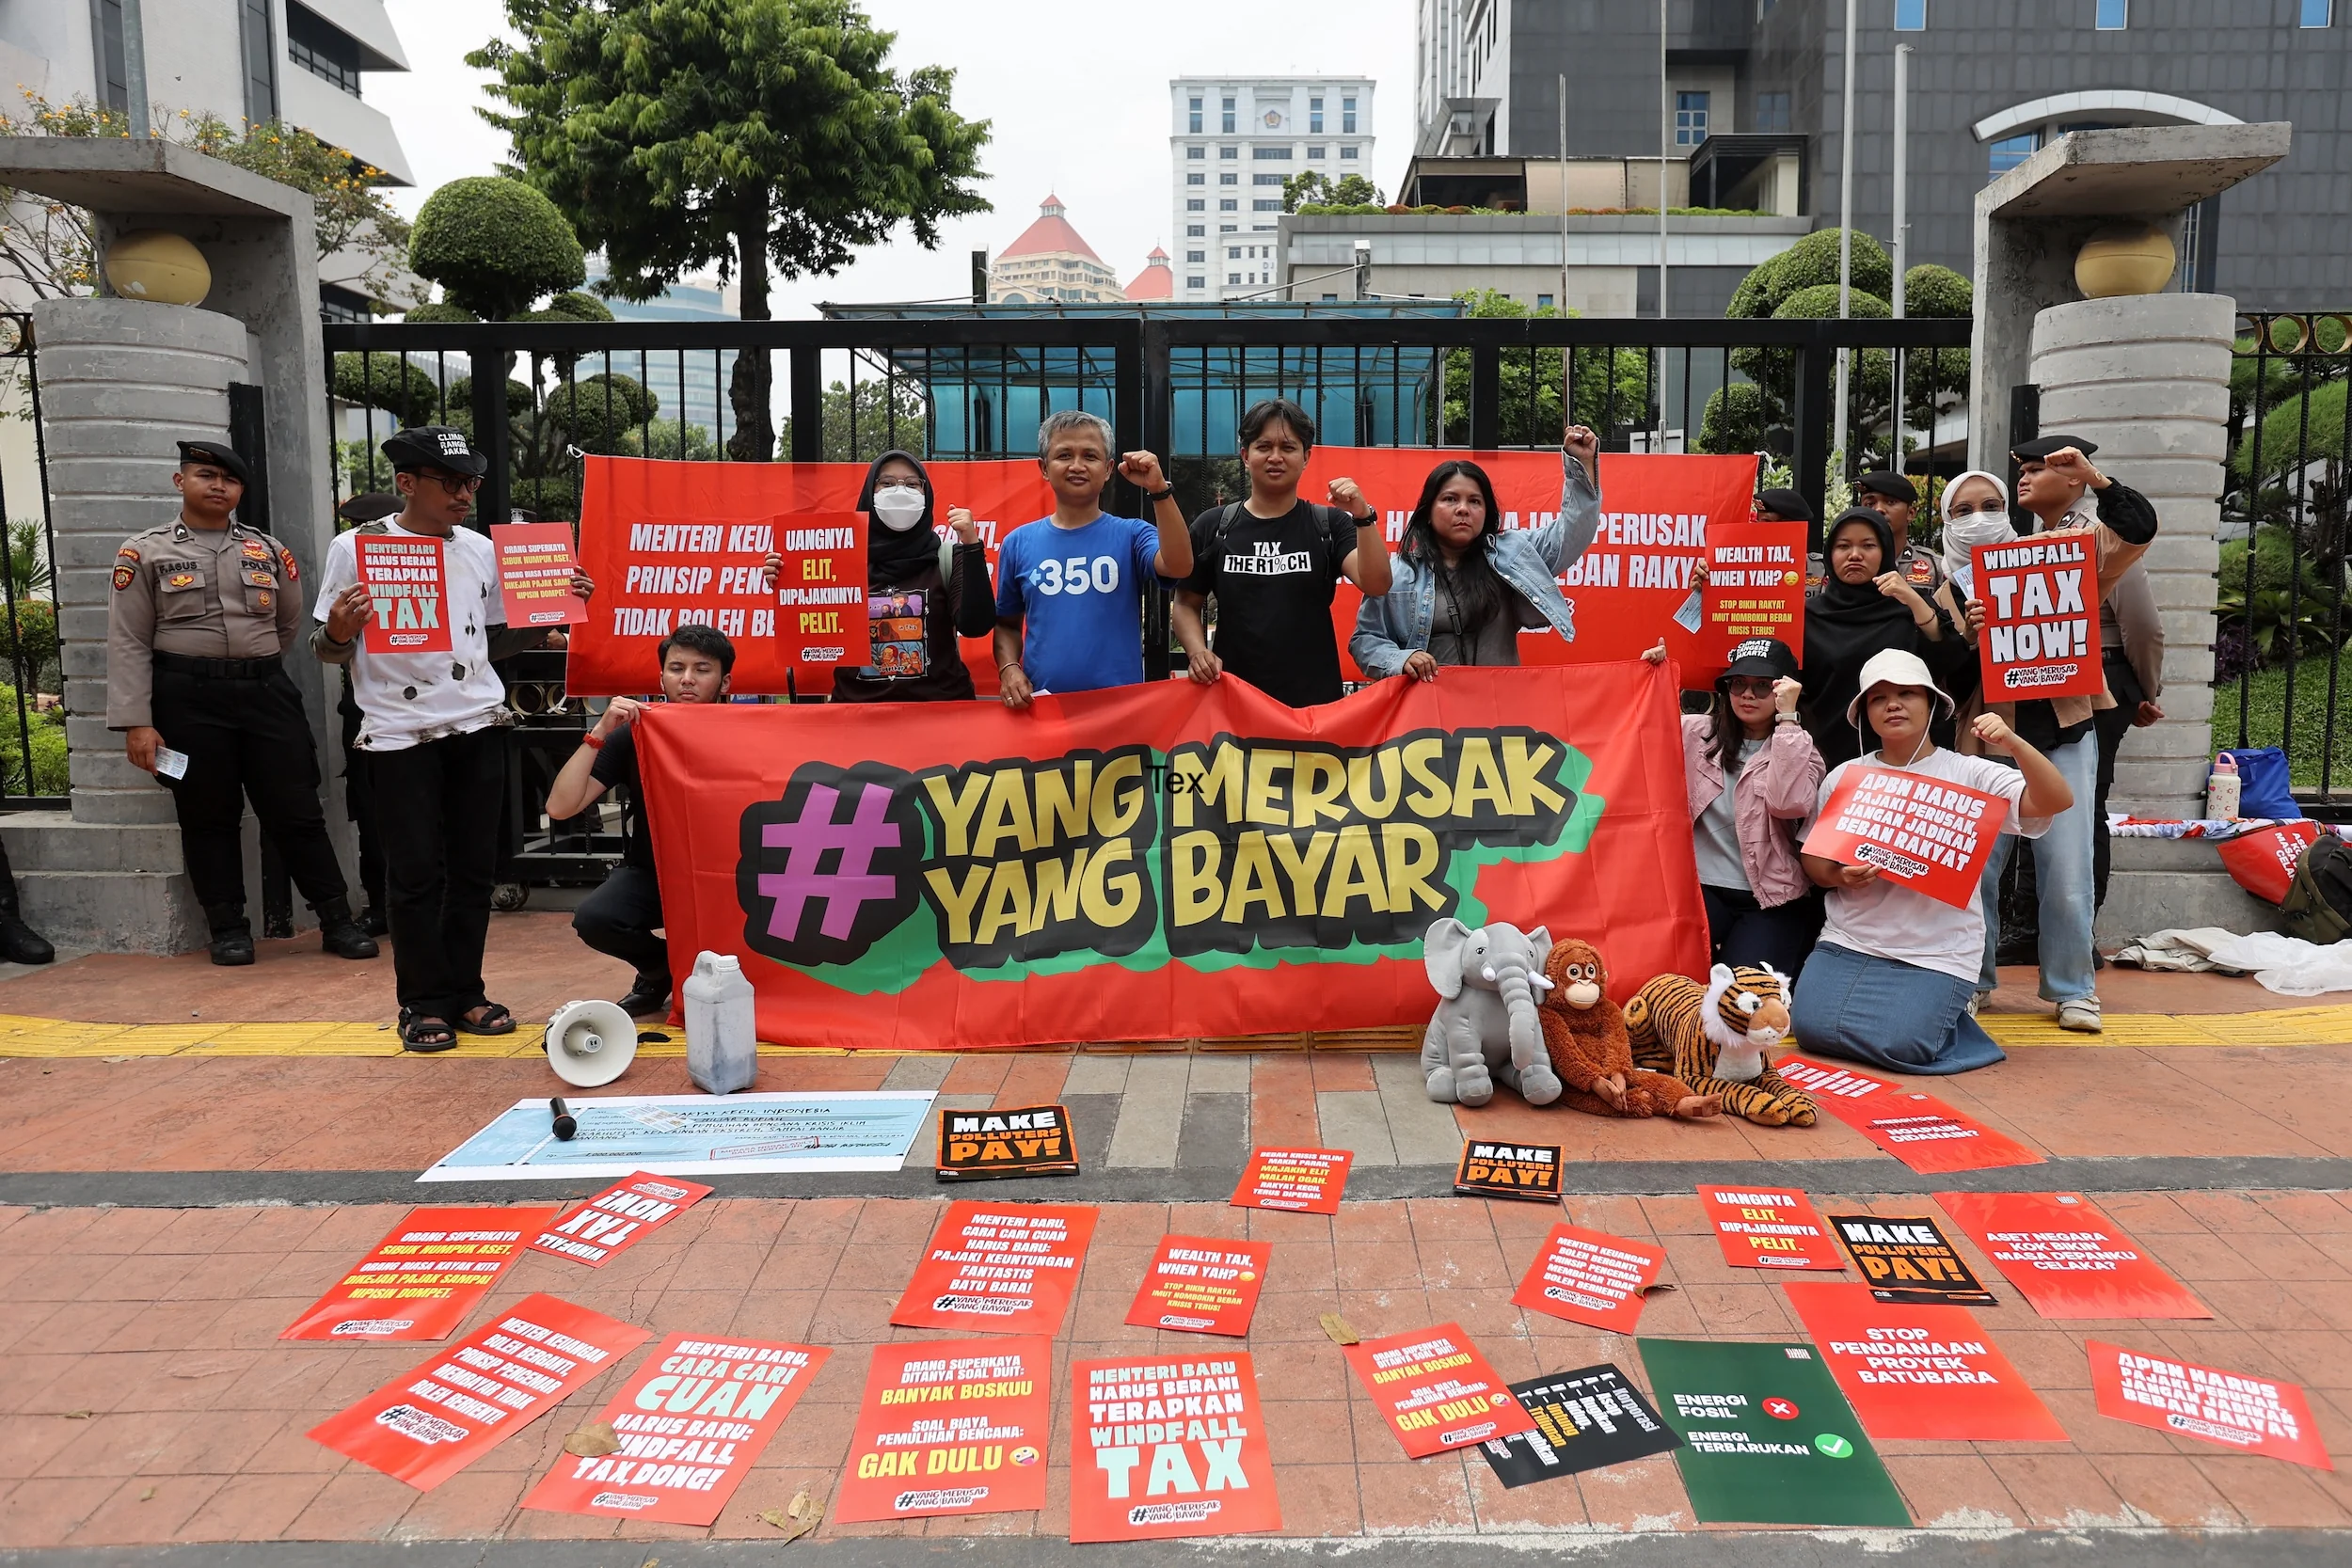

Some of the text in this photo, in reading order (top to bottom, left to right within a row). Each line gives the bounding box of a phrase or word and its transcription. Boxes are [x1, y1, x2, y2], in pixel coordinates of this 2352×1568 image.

[629, 523, 723, 552] MENTERI
[786, 527, 853, 551] UANGNYA
[365, 543, 436, 554] MENTERI BARU
[504, 544, 565, 554] ORANG SUPERKAYA
[1253, 542, 1281, 556] TAX
[1715, 546, 1795, 563] WEALTH TAX,
[1983, 542, 2085, 571] WINDFALL
[365, 555, 436, 566] HARUS BERANI
[803, 559, 836, 581] ELIT,
[366, 567, 437, 581] TERAPKAN
[626, 565, 712, 594] PRINSIP
[1038, 556, 1119, 596] 350
[1709, 570, 1782, 586] WHEN YAH?
[780, 587, 862, 606] DIPAJAKINNYA
[1720, 600, 1756, 610] STOP BIKIN
[1989, 569, 2085, 620] TAX
[373, 598, 439, 629] TAX
[613, 608, 672, 636] TIDAK
[800, 612, 844, 633] PELIT.
[1990, 619, 2089, 664] NOW!
[2041, 665, 2077, 674] MERUSAK
[921, 736, 1566, 858] YANG MERUSAK
[1859, 773, 1987, 819] APBN HARUS
[1852, 790, 1978, 837] PAJAKI PERUSAK,
[1844, 803, 1978, 854] JANGAN JADIKAN
[1836, 816, 1970, 872] BEBAN RAKYAT
[922, 822, 1448, 945] YANG BAYAR
[953, 1111, 1056, 1132] MAKE
[949, 1128, 1061, 1142] POLLUTERS
[950, 1137, 1061, 1161] PAY!
[1473, 1145, 1552, 1163] MAKE
[1470, 1158, 1554, 1171] POLLUTERS
[1467, 1165, 1552, 1186] PAY!
[591, 1189, 678, 1223] NOW!
[1714, 1193, 1796, 1207] UANGNYA
[555, 1209, 642, 1247] TAX
[971, 1214, 1027, 1227] MENTERI
[1720, 1222, 1820, 1237] DIPAJAKINNYA
[400, 1231, 521, 1242] ORANG SUPERKAYA
[961, 1226, 1068, 1241] CARA CARI CUAN
[1748, 1236, 1804, 1251] PELIT.
[1841, 1223, 1939, 1244] MAKE
[1987, 1232, 2109, 1242] ASET NEGARA
[379, 1244, 478, 1255] SIBUK NUMPUK
[534, 1232, 610, 1261] WINDFALL
[965, 1240, 1051, 1253] HARUS BARU:
[1168, 1249, 1221, 1263] WEALTH
[1557, 1237, 1651, 1266] MENTERI KEUANGAN
[1559, 1247, 1589, 1260] BOLEH
[1851, 1244, 1950, 1257] POLLUTERS
[1994, 1251, 2137, 1260] MASA DEPANKU
[2010, 1243, 2101, 1251] KOK BIKIN
[360, 1262, 401, 1272] ORANG
[931, 1250, 1074, 1268] PAJAKI KEUNTUNGAN
[1549, 1254, 1643, 1283] PRINSIP PENCEMAR
[1859, 1257, 1966, 1281] PAY!
[2033, 1261, 2116, 1270] CELAKA?
[960, 1265, 1034, 1279] FANTASTIS
[1157, 1262, 1238, 1280] WHEN YAH?
[1547, 1263, 1604, 1283] MEMBAYAR
[498, 1317, 610, 1363] MENTERI KEUANGAN
[1866, 1328, 1929, 1340] STOP
[482, 1334, 526, 1357] BOLEH
[674, 1340, 809, 1368] MENTERI BARU,
[1373, 1338, 1452, 1362] ORANG SUPERKAYA
[1829, 1342, 1987, 1354] PENDANAAN
[453, 1347, 564, 1395] PRINSIP PENCEMAR
[660, 1355, 799, 1385] CARA CARI
[904, 1355, 1021, 1372] ORANG SUPERKAYA
[1090, 1361, 1236, 1384] MENTERI BARU
[1866, 1356, 1969, 1369] PROYEK
[901, 1366, 1025, 1384] DITANYA SOAL DUIT:
[1857, 1370, 1999, 1384] BATUBARA
[2118, 1352, 2280, 1400] APBN HARUS
[2121, 1367, 2191, 1391] PAJAKI
[432, 1363, 537, 1410] MEMBAYAR TIDAK
[881, 1381, 1033, 1404] BANYAK BOSKUU
[1089, 1376, 1240, 1401] HARUS BERANI
[407, 1379, 508, 1425] BOLEH BERHENTI!
[635, 1375, 785, 1420] CUAN
[1089, 1393, 1244, 1423] TERAPKAN
[1673, 1394, 1748, 1405] ENERGI
[2121, 1379, 2296, 1426] JANGAN JADIKAN
[1546, 1402, 1580, 1437] Untung
[1677, 1406, 1739, 1418] FOSIL
[2122, 1386, 2299, 1441] BEBAN RAKYAT
[612, 1413, 755, 1441] HARUS BARU:
[912, 1417, 988, 1432] SOAL BIAYA
[1089, 1417, 1248, 1448] WINDFALL
[1529, 1405, 1567, 1448] Triliunan
[877, 1430, 955, 1446] PEMULIHAN
[1687, 1432, 1749, 1442] ENERGI
[1691, 1442, 1810, 1456] TERBARUKAN
[858, 1446, 1003, 1479] GAK DULU
[1096, 1438, 1249, 1498] TAX
[572, 1457, 726, 1491] TAX, DONG!
